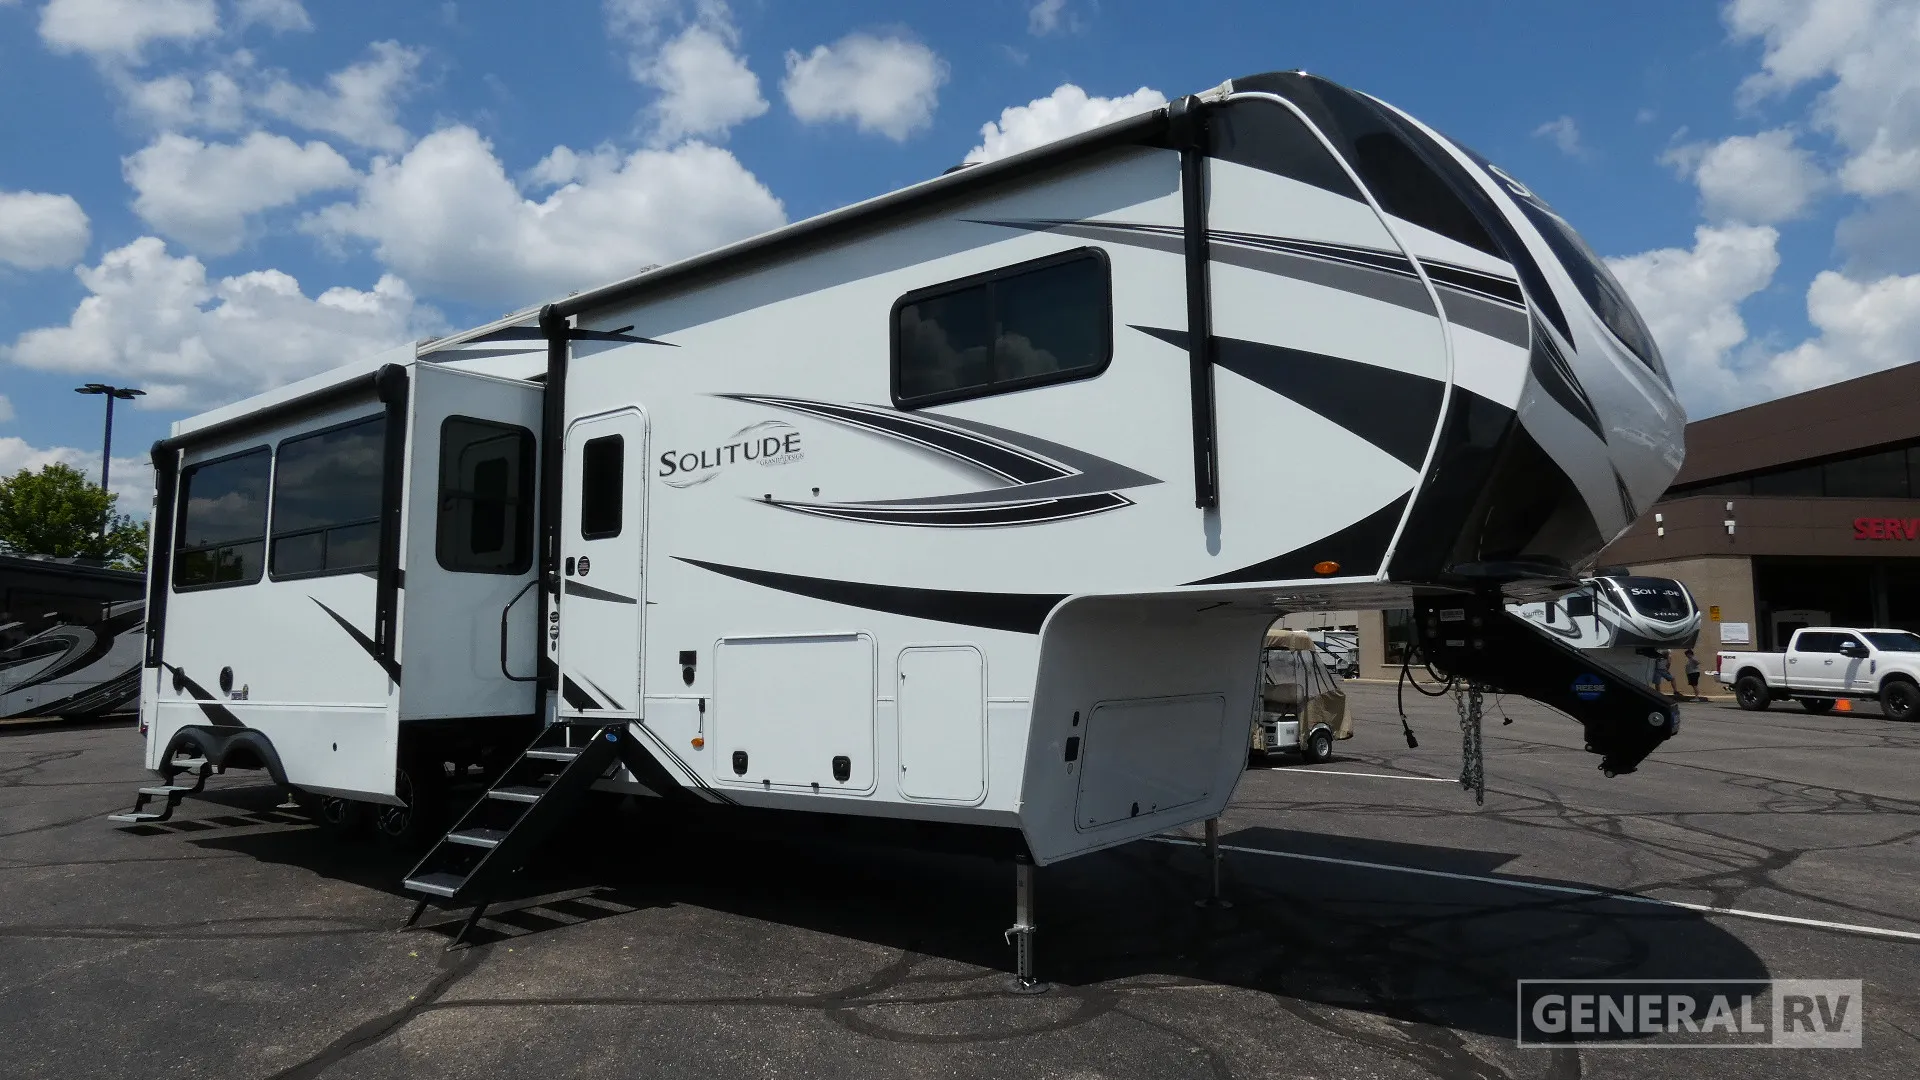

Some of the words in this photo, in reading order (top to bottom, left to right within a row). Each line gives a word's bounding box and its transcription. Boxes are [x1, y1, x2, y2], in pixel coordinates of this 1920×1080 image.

[659, 431, 801, 477] SOLITUDE
[1853, 517, 1920, 540] SERV
[1575, 684, 1606, 692] REESE
